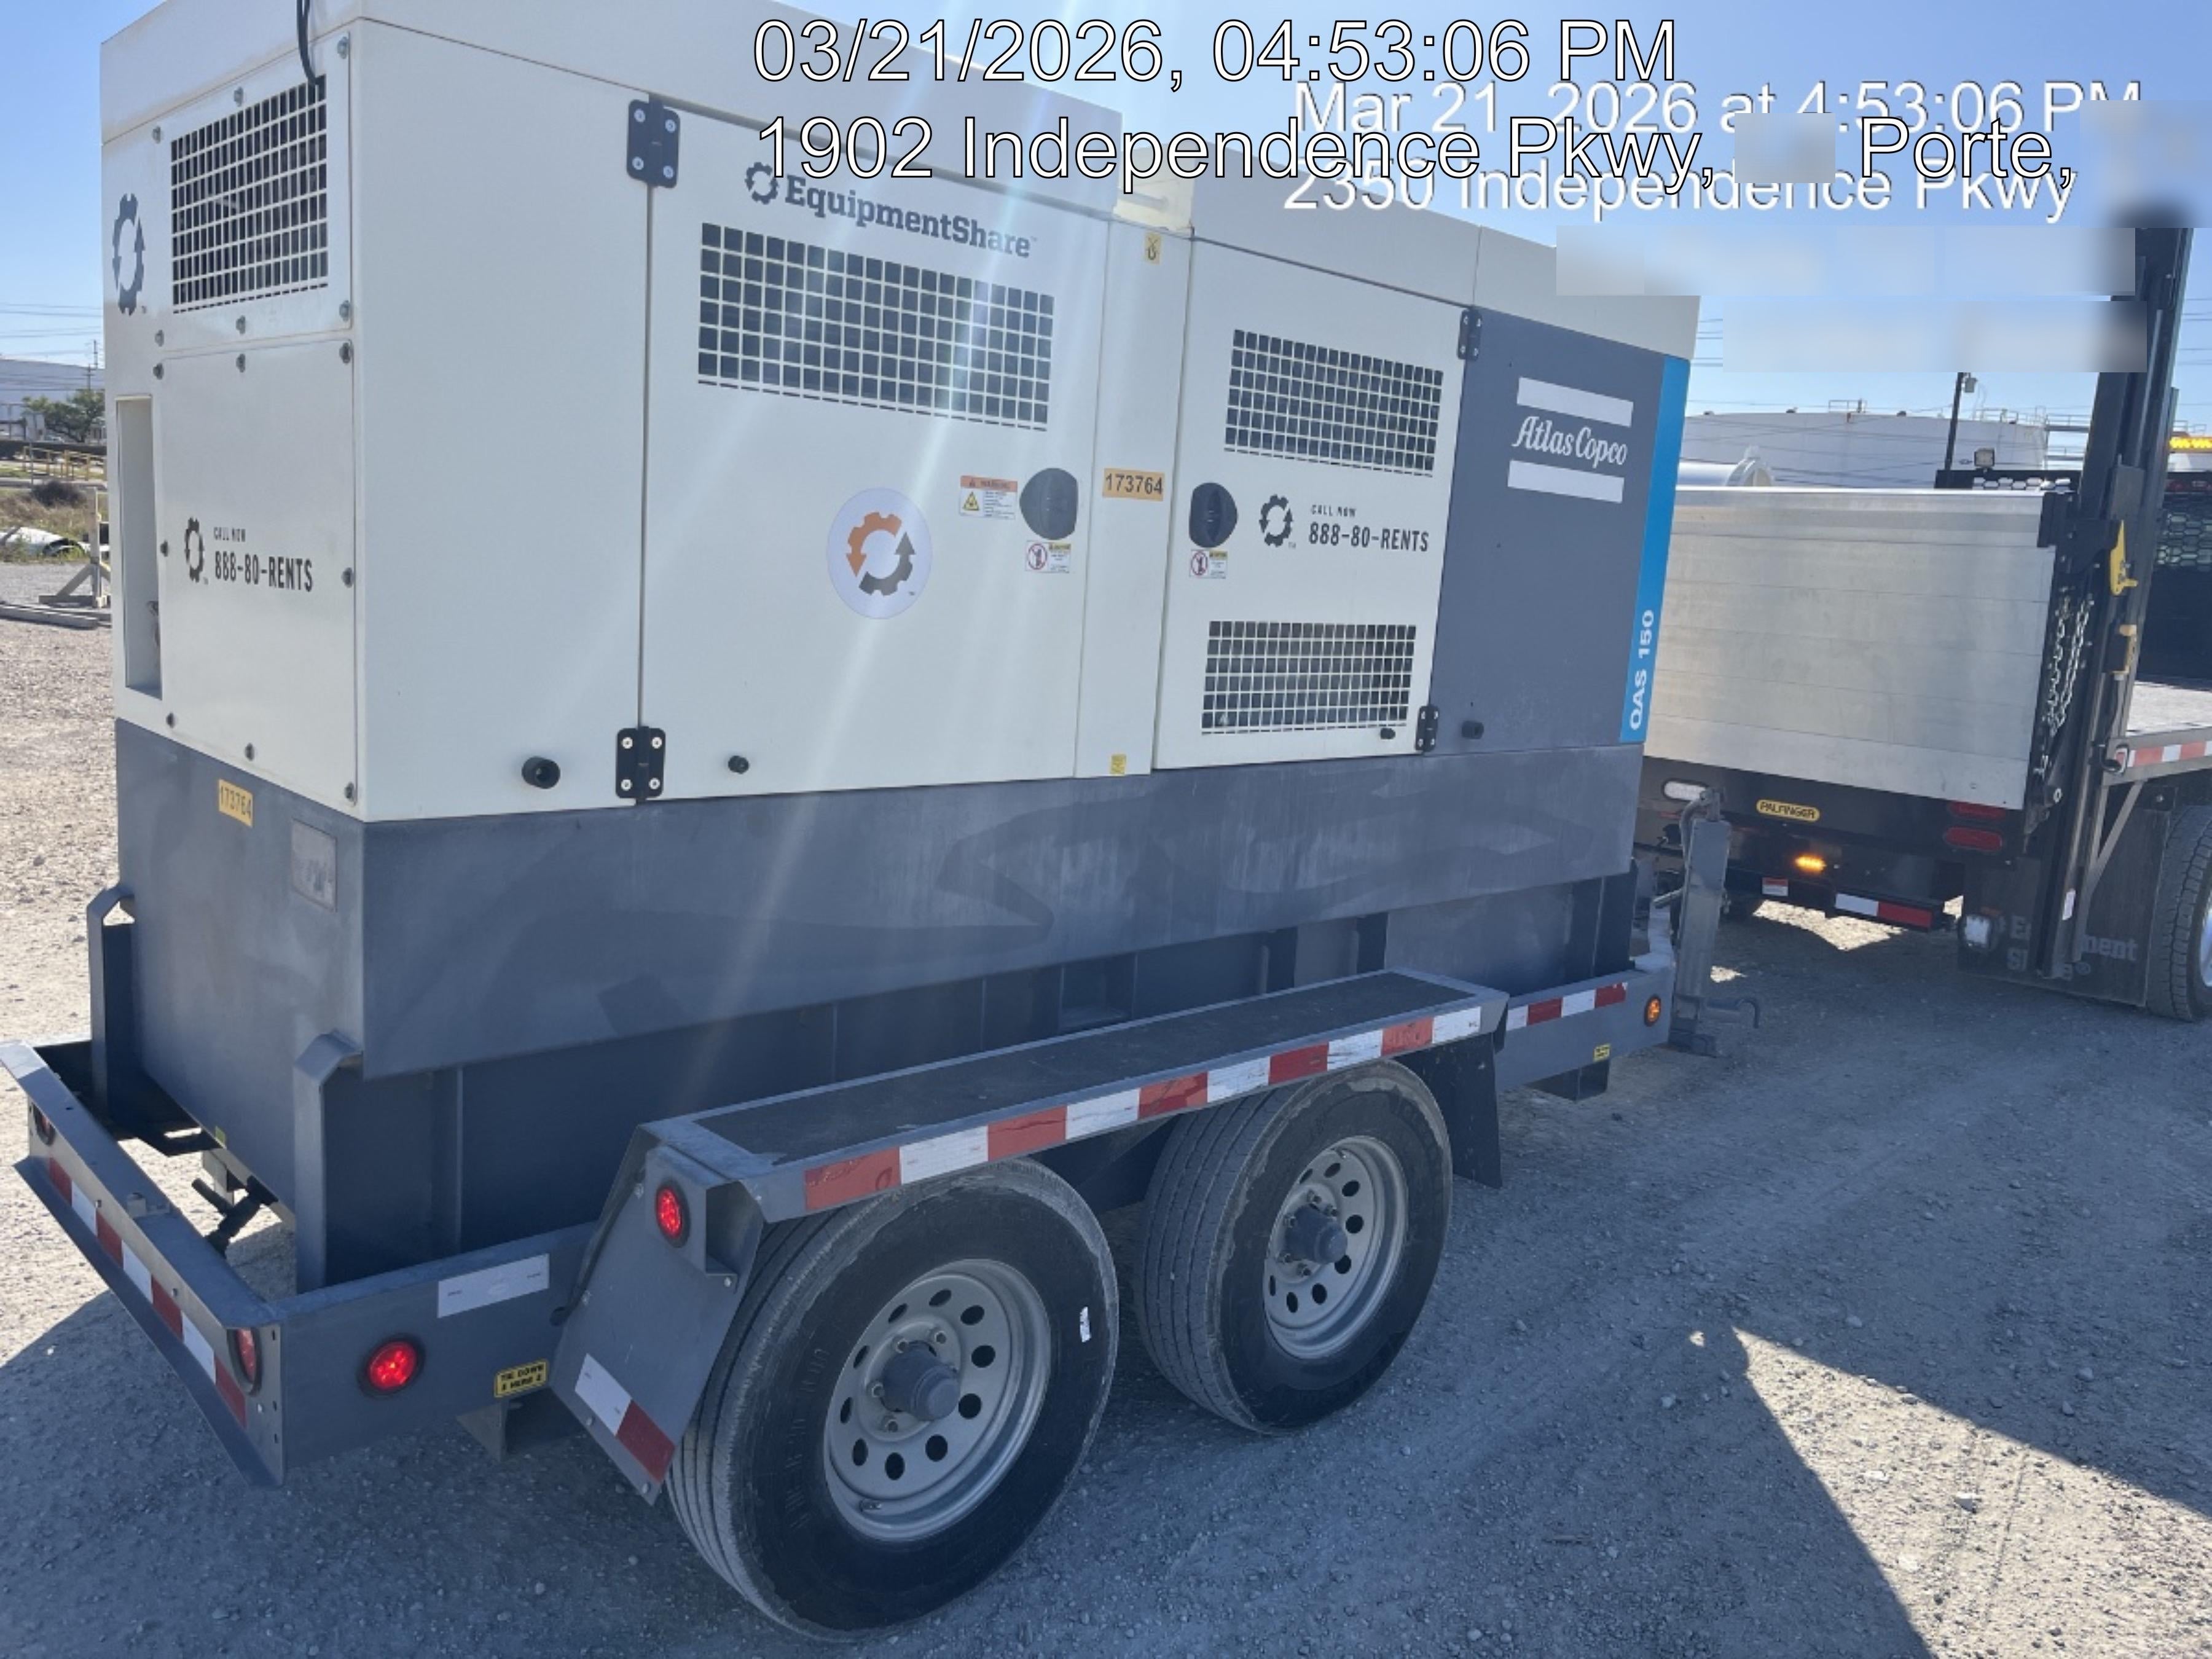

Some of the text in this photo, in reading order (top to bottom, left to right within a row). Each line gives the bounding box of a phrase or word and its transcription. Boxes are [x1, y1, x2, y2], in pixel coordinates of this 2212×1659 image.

[785, 174, 1030, 258] EquipmentShare
[1511, 416, 1628, 469] Atlas Copco
[1105, 473, 1163, 494] 173764
[1311, 504, 1333, 516] CALL
[1309, 522, 1429, 552] 888-80-RENTS
[215, 551, 313, 592] 888-80-RENTS
[1630, 610, 1654, 731] QAS 150
